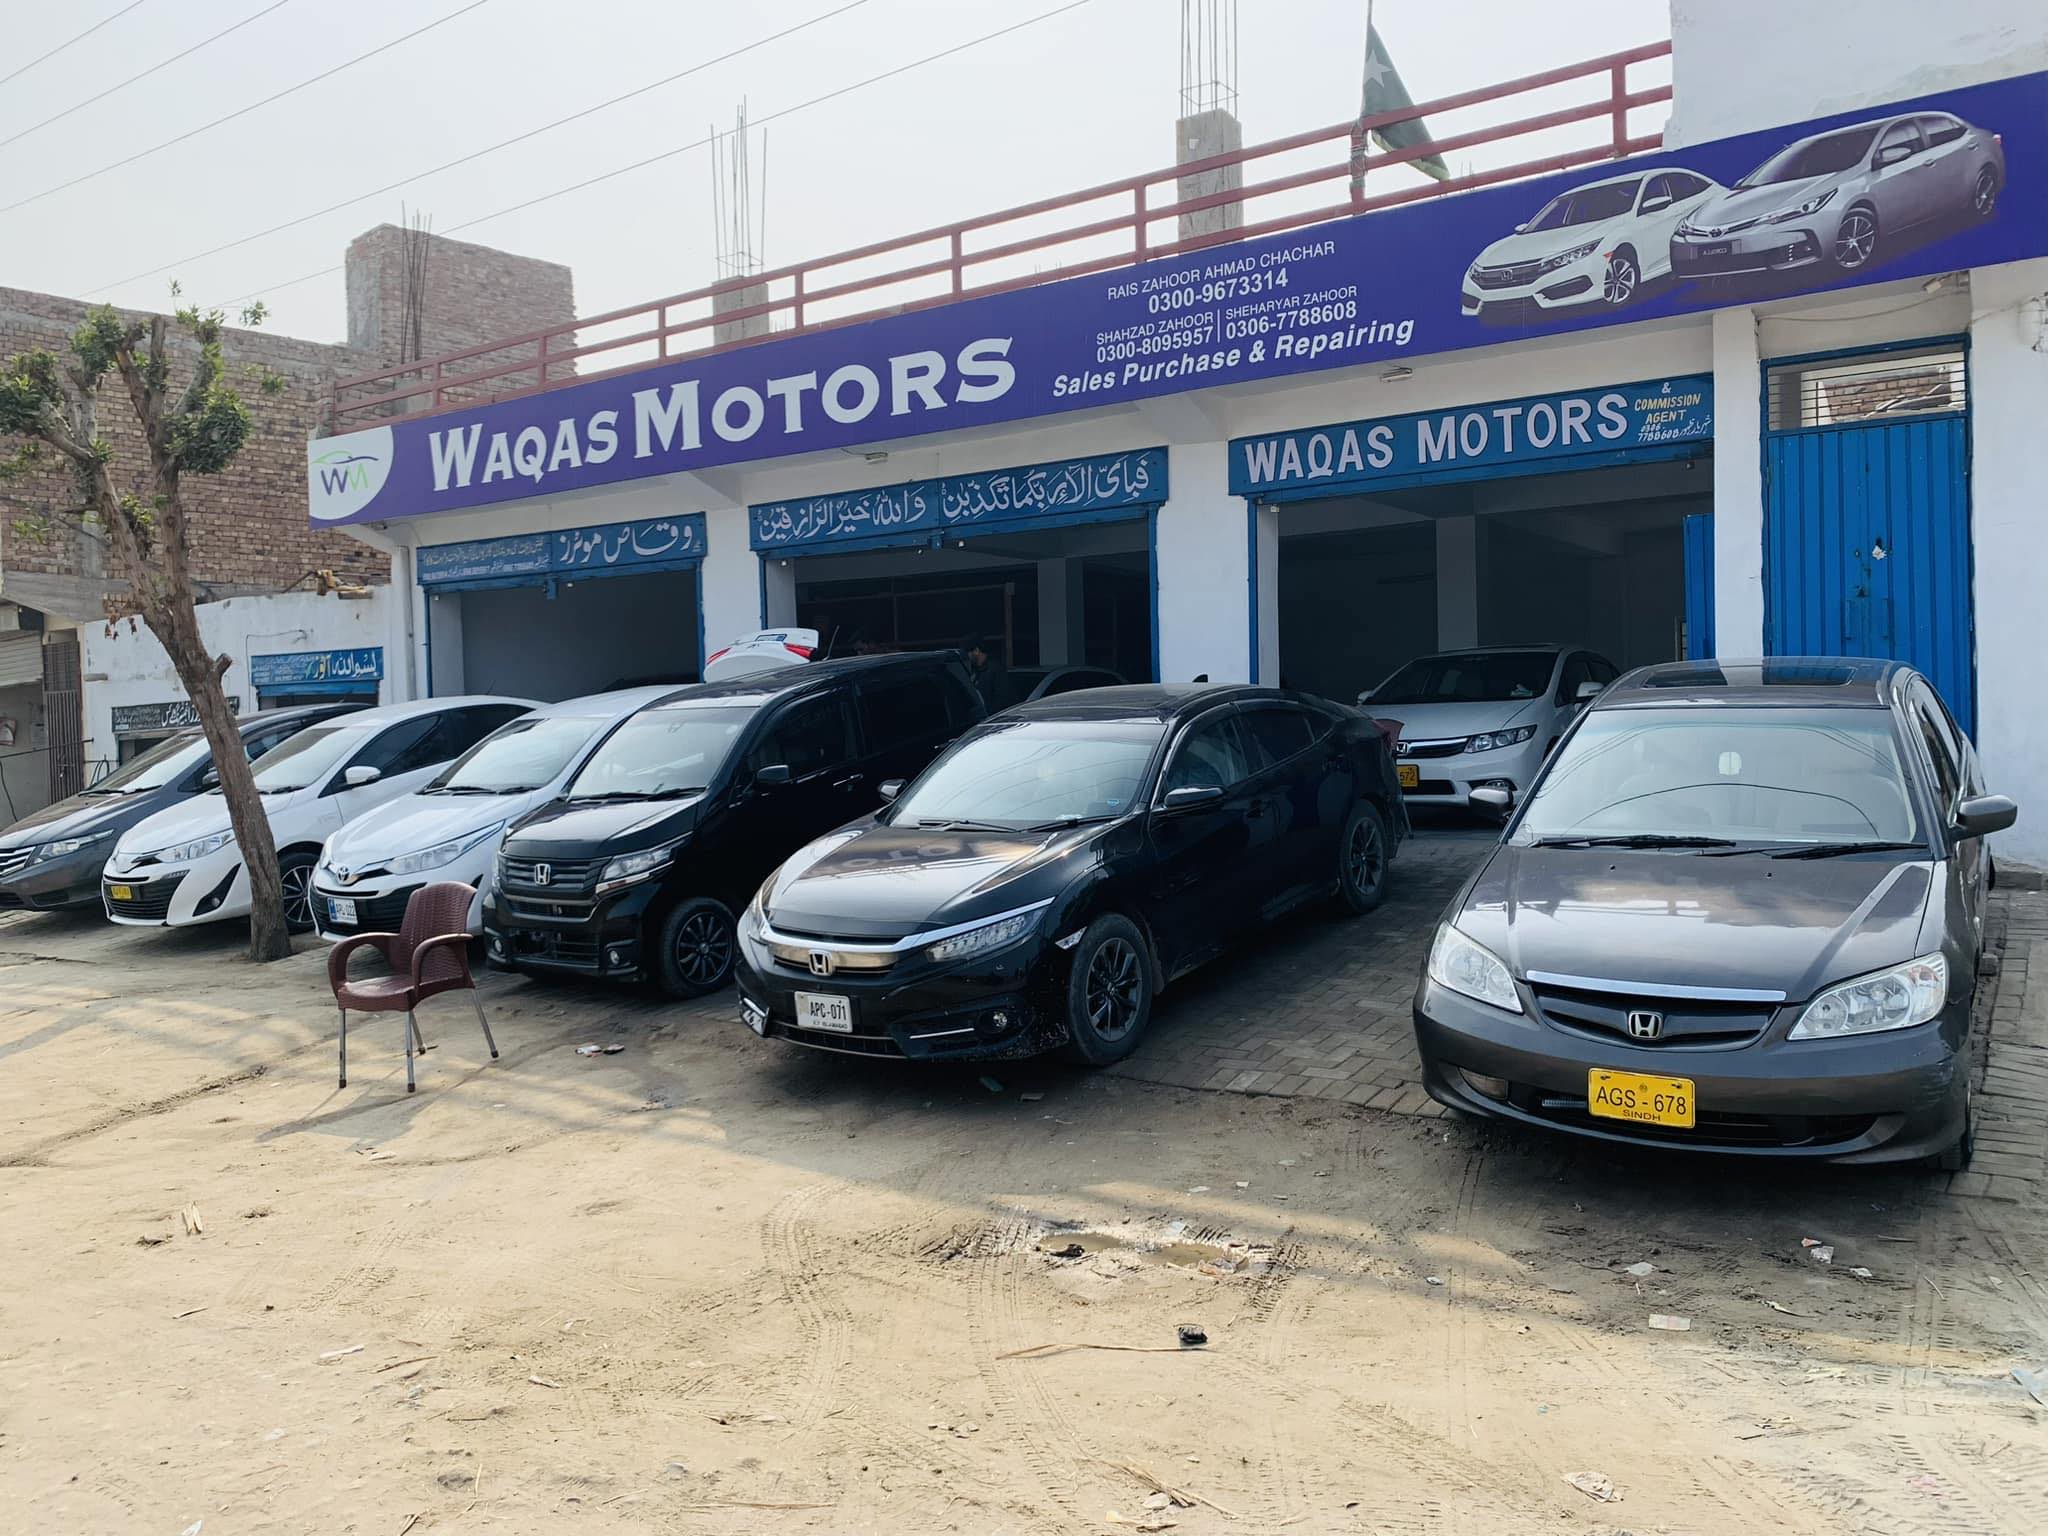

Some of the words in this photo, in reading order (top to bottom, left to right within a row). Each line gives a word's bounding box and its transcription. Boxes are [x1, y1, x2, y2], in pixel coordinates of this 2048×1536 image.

[1107, 281, 1138, 301] RAIS
[1141, 268, 1200, 293] ZAHOOR
[1203, 257, 1257, 281] AHMAD
[1259, 240, 1336, 267] CHACHAR
[1148, 267, 1289, 315] 0300-9673314
[1225, 295, 1301, 320] SHEHARYAR
[1303, 285, 1358, 307] ZAHOOR
[1096, 323, 1155, 345] SHAHZAD
[1158, 311, 1214, 334] ZAHOOR
[1225, 300, 1358, 340] 0306-7788608
[1052, 368, 1116, 398] Sales
[1122, 346, 1241, 386] Purchase
[1248, 342, 1266, 364] &
[1275, 318, 1415, 361] Repairing
[1096, 326, 1214, 364] 0300-8095957
[1634, 393, 1702, 411] COMMISSION
[1661, 382, 1672, 394] &
[429, 409, 619, 492] WAQAS
[633, 337, 1016, 459] MOTORS
[1645, 409, 1687, 425] AGENT
[1244, 425, 1394, 485] WAQAS
[1417, 392, 1628, 464] MOTORS
[810, 1000, 847, 1021] APC-071
[1623, 1110, 1661, 1121] SINDH
